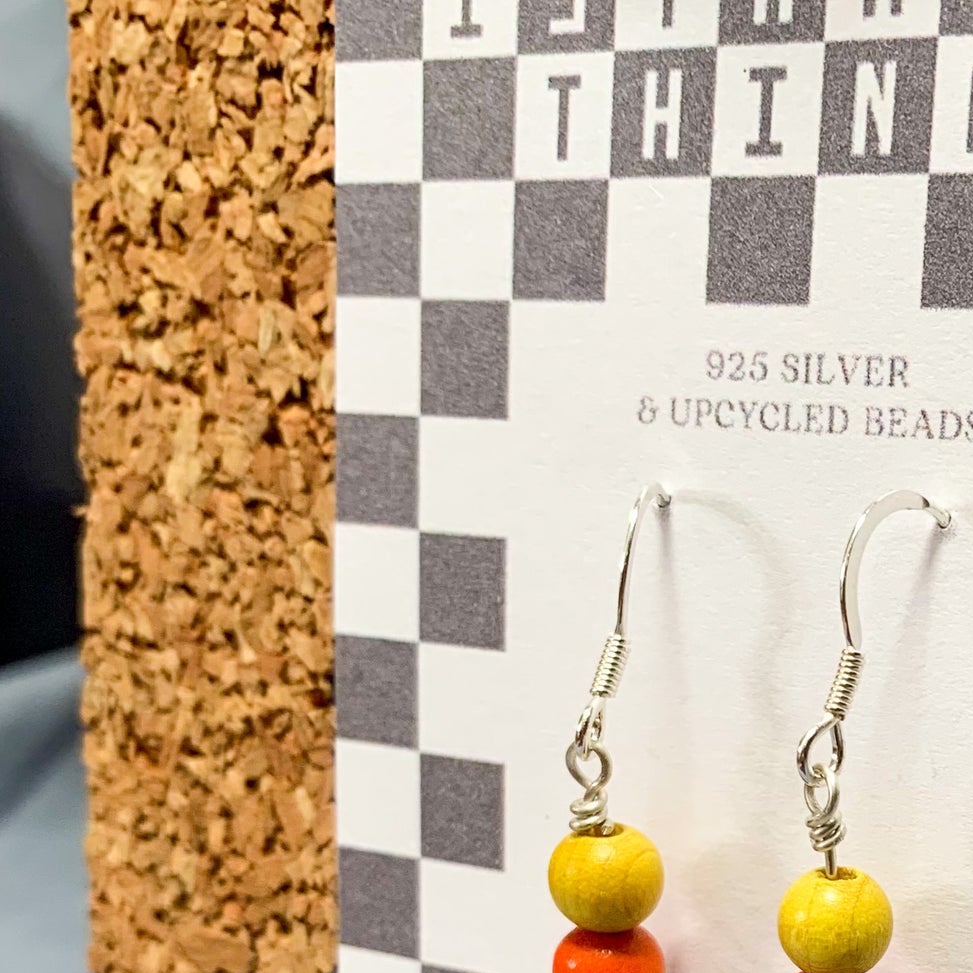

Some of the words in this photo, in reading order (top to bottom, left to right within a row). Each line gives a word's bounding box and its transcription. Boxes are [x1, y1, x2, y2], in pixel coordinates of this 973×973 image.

[705, 349, 769, 383] 925
[780, 352, 910, 388] SILVER
[637, 395, 660, 426] &
[670, 397, 850, 436] UPCYCLED
